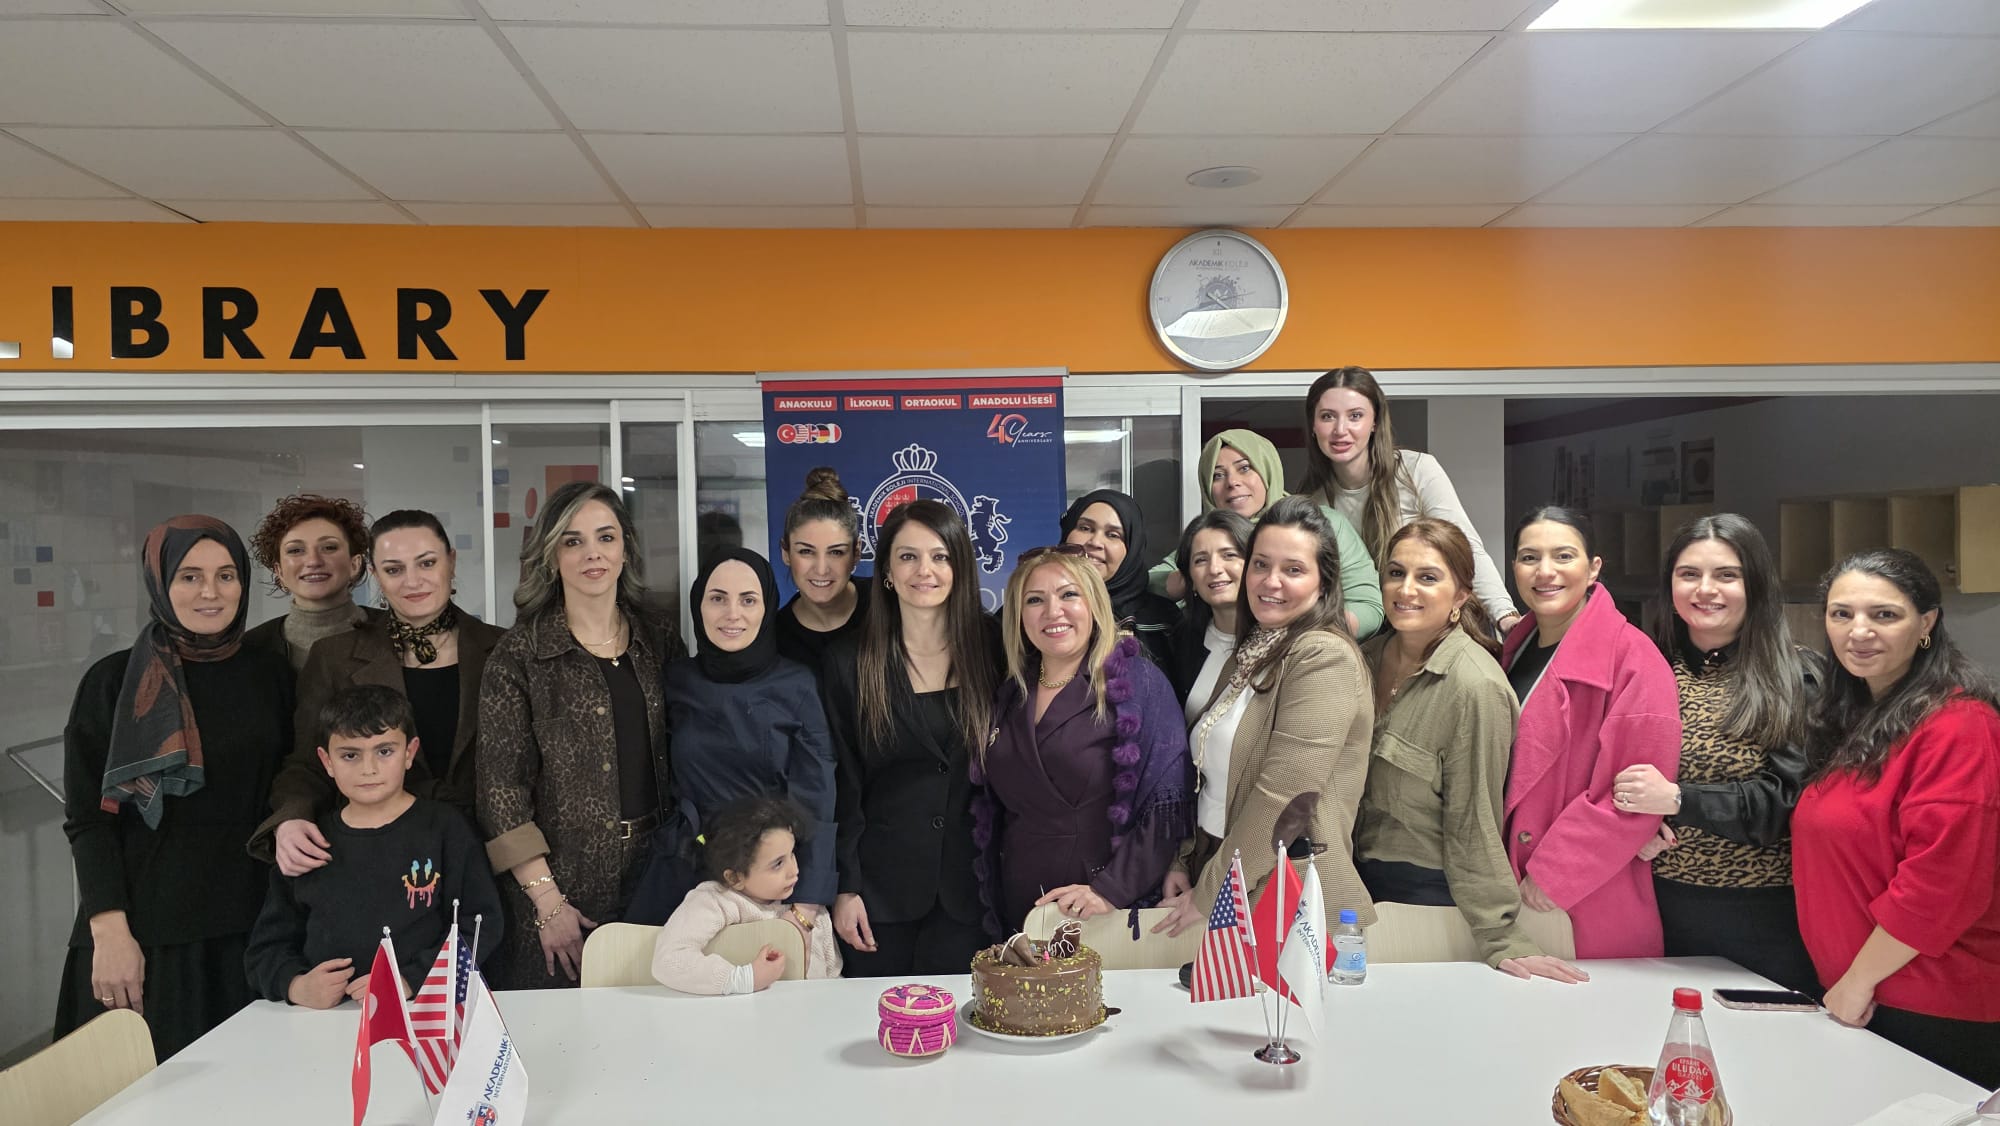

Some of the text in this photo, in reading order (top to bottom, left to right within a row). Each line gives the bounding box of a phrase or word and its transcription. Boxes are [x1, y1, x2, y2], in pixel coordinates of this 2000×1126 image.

[0, 286, 550, 360] IBRARY
[779, 400, 832, 409] ANAOKULU
[850, 398, 891, 408] İLKOKUL
[905, 398, 957, 407] ORTAOKUL
[973, 395, 1053, 406] ANADOLU LİSESİ
[987, 413, 1027, 444] 40
[950, 493, 966, 517] SCHOOL
[483, 1038, 509, 1101] AKADEMIK
